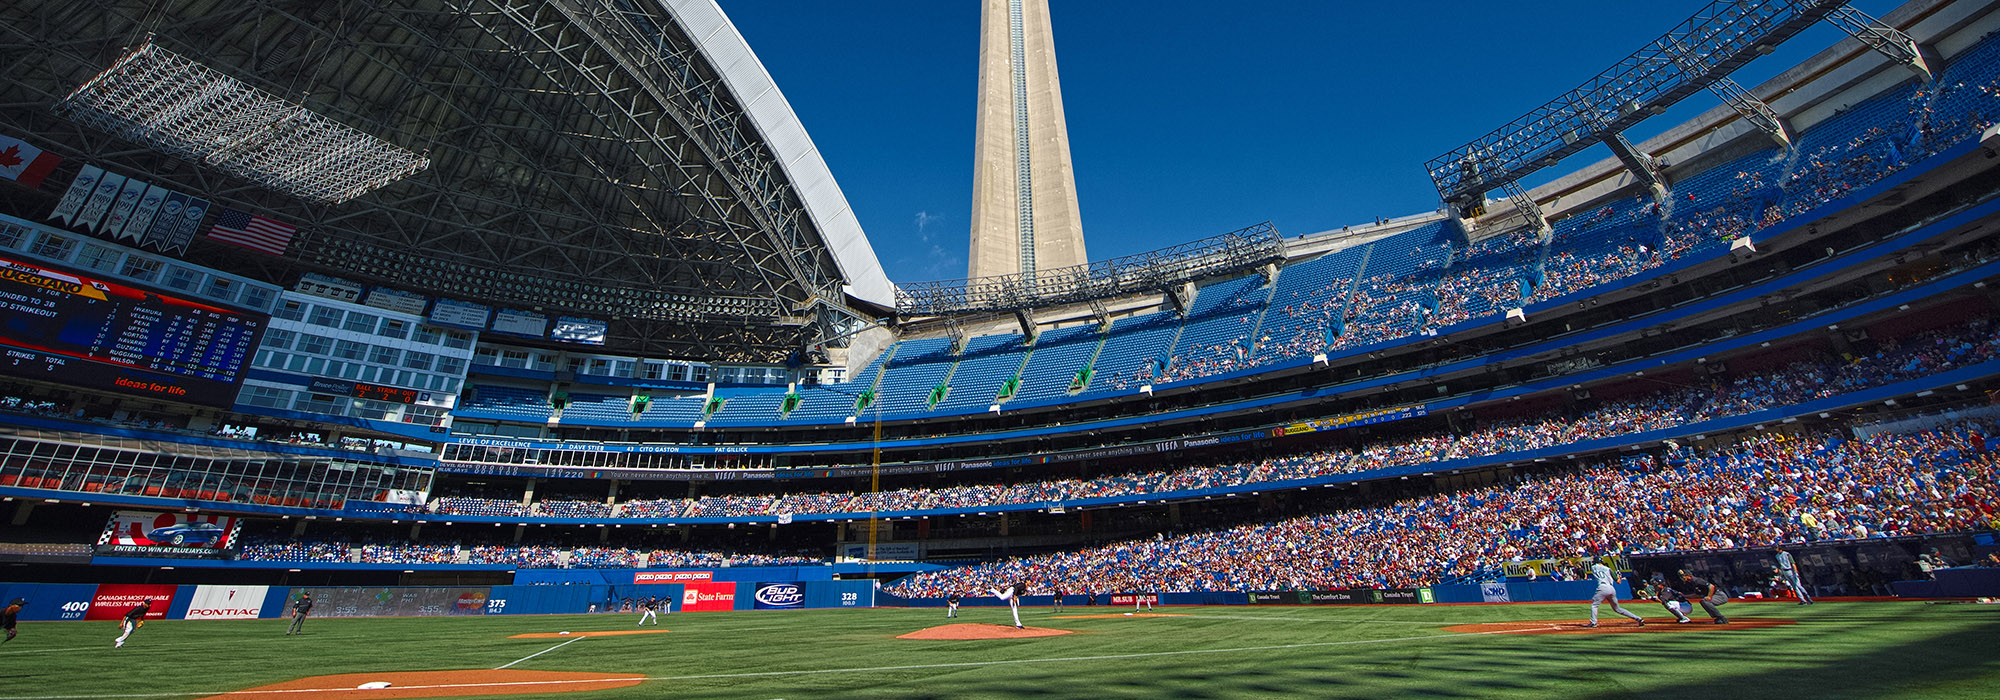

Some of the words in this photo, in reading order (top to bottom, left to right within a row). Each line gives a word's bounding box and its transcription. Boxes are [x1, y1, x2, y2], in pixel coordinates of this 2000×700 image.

[0, 268, 82, 293] UGGIANO
[46, 289, 61, 297] FOR
[30, 297, 42, 305] TO
[44, 300, 56, 308] 3B
[10, 303, 59, 318] STRIKEOUT
[128, 325, 150, 334] UPTON
[122, 331, 149, 341] NORTON
[116, 343, 143, 353] GUZMAN
[6, 350, 36, 361] STRIKES
[45, 356, 66, 366] TOTAL
[109, 349, 144, 360] RUGGIANO
[110, 356, 136, 365] WILSON
[47, 364, 55, 372] 5
[114, 376, 148, 390] ideas
[149, 382, 168, 393] for
[168, 385, 187, 396] life
[356, 384, 372, 392] BALL
[376, 387, 399, 395] STRIKE
[402, 390, 416, 398] OUT
[358, 391, 366, 399] 2
[404, 396, 411, 404] 0
[491, 440, 531, 448] EXCELLENCE
[1076, 452, 1092, 460] never
[1092, 450, 1108, 458] seen
[1108, 447, 1134, 458] anything
[1134, 446, 1146, 454] like
[1184, 438, 1220, 449] Panasonic
[1220, 434, 1241, 444] ideas
[1241, 433, 1253, 441] for
[1253, 431, 1266, 439] life
[889, 466, 913, 475] anything
[961, 460, 993, 470] Panasonic
[1011, 458, 1021, 466] for
[666, 472, 691, 481] anything
[742, 472, 776, 480] Panasonic
[114, 545, 137, 553] ENTER
[172, 547, 219, 555] BLUEJAYS.COM
[1506, 562, 1532, 576] Niko
[636, 573, 654, 581] pizza
[654, 573, 673, 581] pizza
[674, 572, 693, 581] pizza
[692, 572, 711, 581] pizza
[767, 586, 798, 594] BUD
[96, 594, 127, 602] CANADA'S
[127, 594, 144, 602] MOST
[698, 592, 716, 601] State
[716, 592, 734, 601] Farm
[763, 592, 803, 603] LIGHT
[842, 592, 858, 601] 328
[61, 601, 90, 612] 400
[488, 599, 506, 608] 375
[189, 608, 259, 617] PONTIAC
